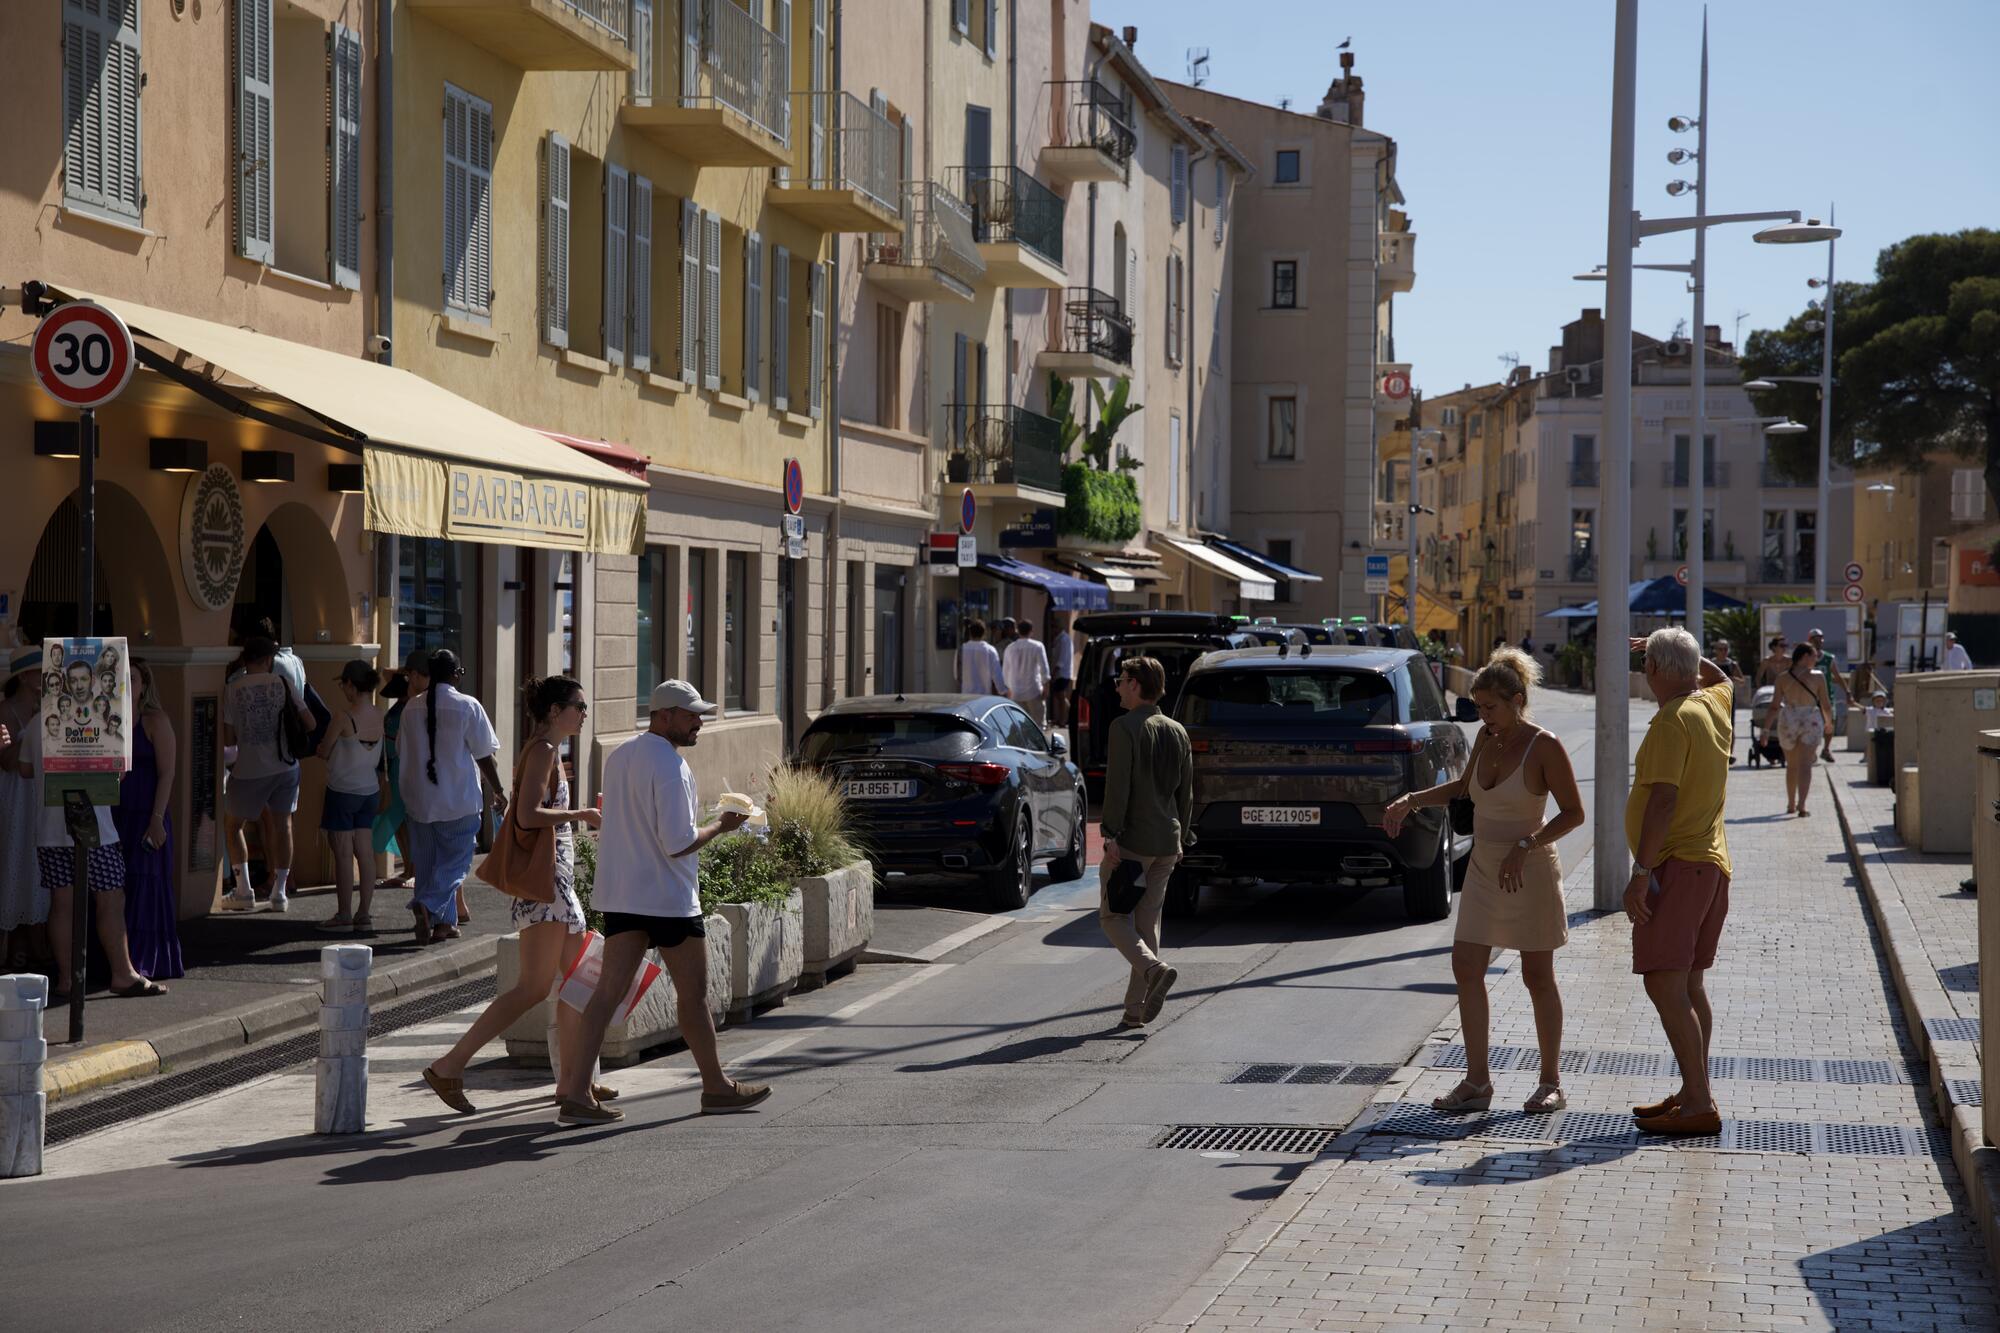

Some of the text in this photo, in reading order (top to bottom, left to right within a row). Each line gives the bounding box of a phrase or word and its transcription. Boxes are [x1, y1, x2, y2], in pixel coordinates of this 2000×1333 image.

[53, 333, 111, 376] 30
[453, 471, 587, 529] BARBARAC
[961, 540, 974, 549] SAUF
[961, 553, 974, 562] TAXIS
